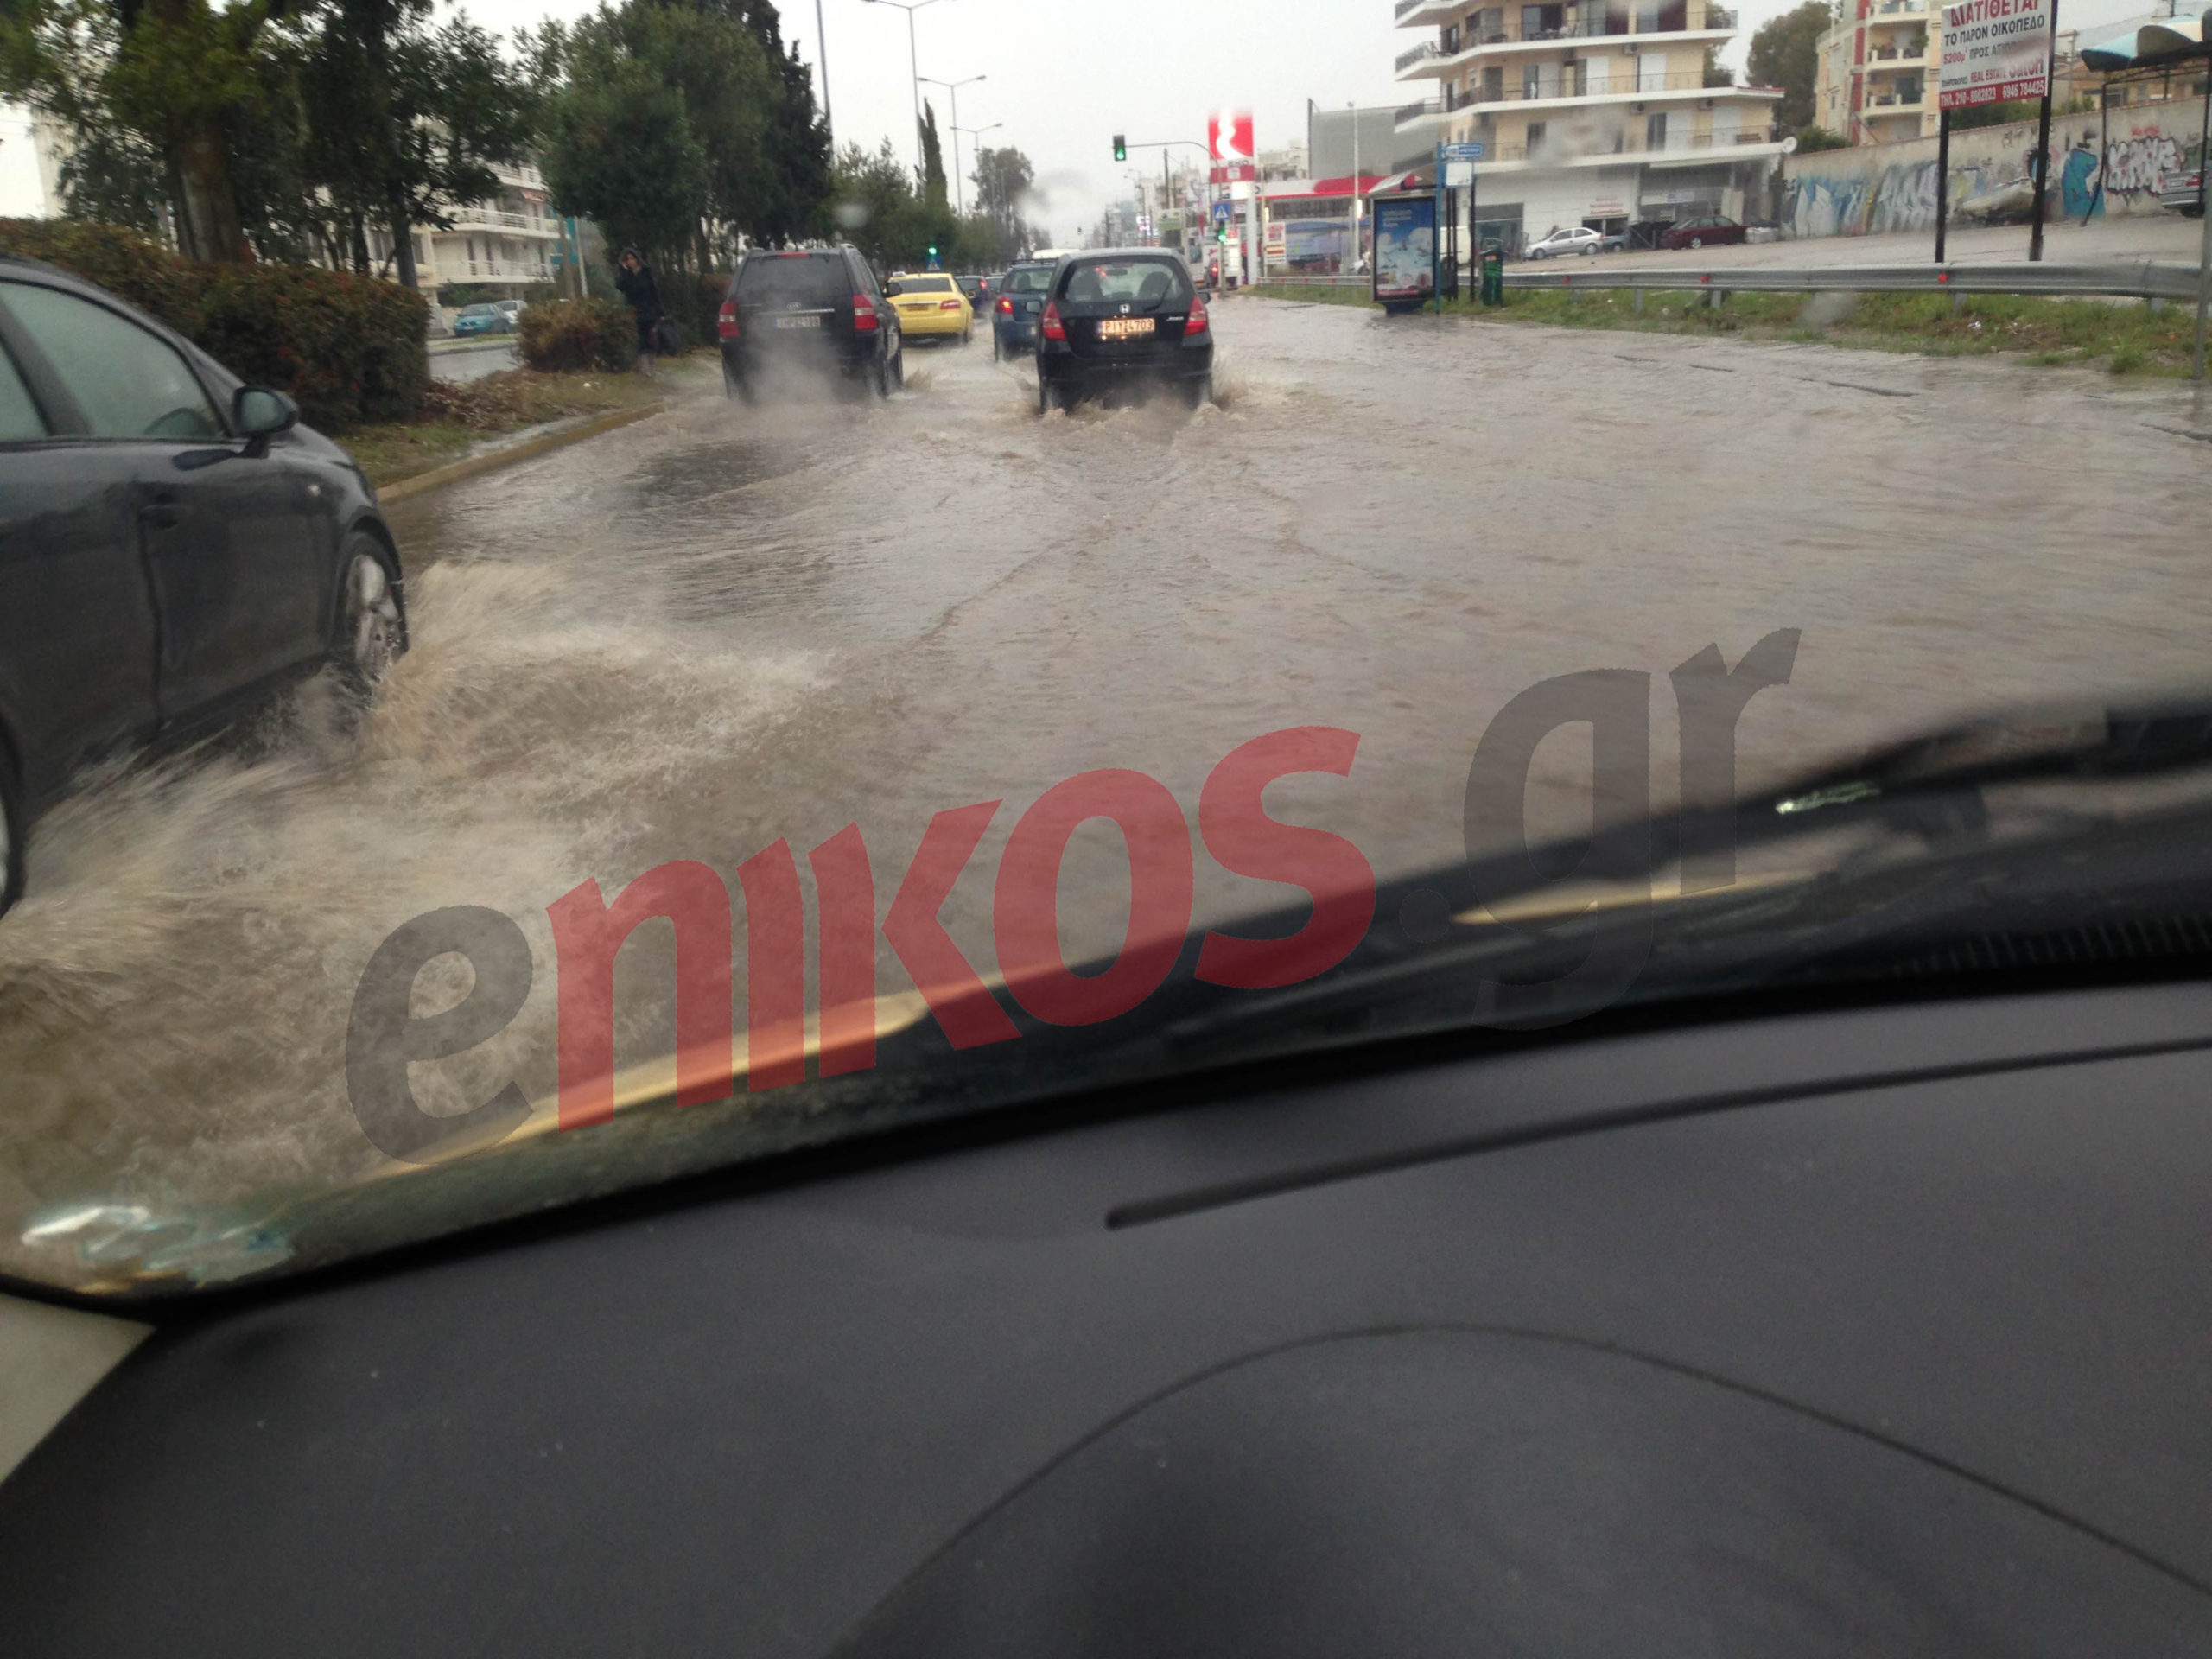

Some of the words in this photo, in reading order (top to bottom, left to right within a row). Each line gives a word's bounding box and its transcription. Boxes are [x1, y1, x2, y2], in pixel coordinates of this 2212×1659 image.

[1944, 33, 1957, 46] ΤΟ
[1960, 25, 1987, 43] ΠΑΡΟΝ
[1991, 15, 2044, 37] ΟΙΚΟΠΕΔΟ
[1970, 46, 1989, 60] ΠΡΟΣ
